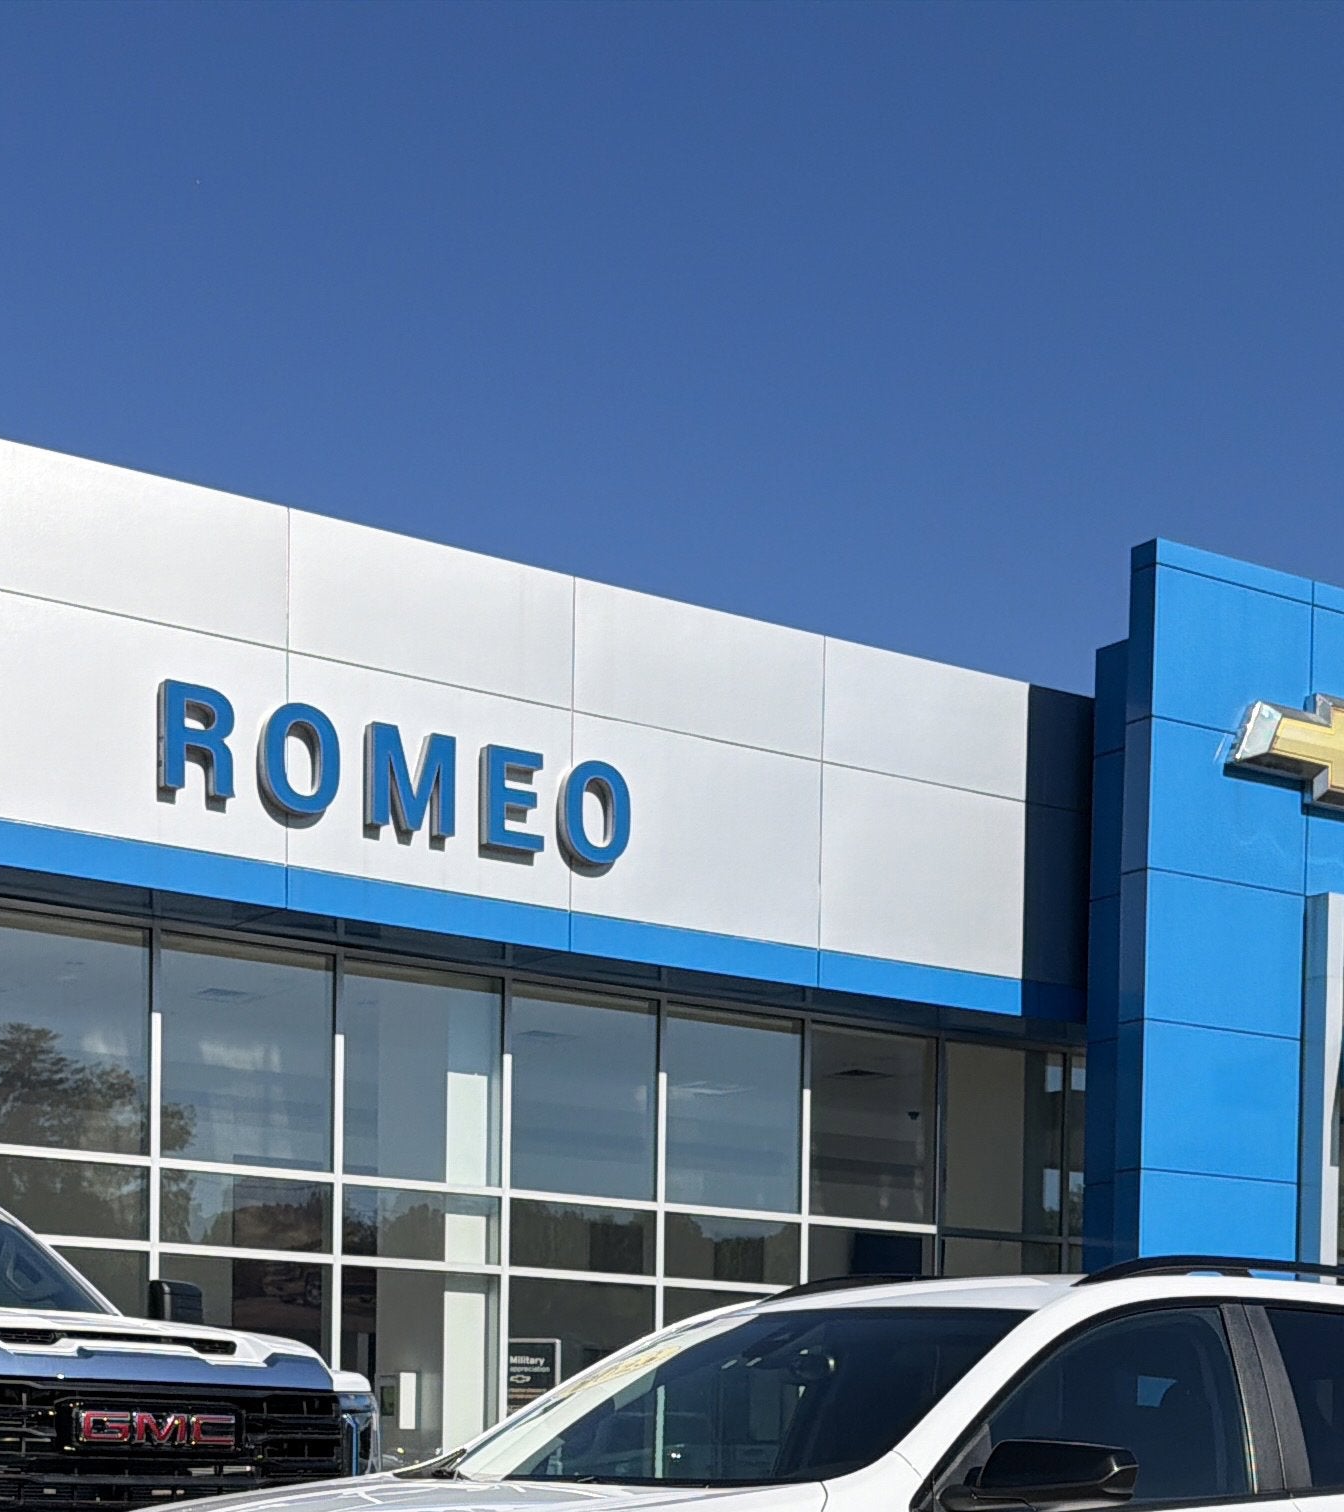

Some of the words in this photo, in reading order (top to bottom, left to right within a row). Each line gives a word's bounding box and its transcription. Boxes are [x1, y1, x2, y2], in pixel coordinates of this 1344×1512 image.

[157, 679, 631, 866] ROMEO
[510, 1355, 545, 1366] Military
[81, 1410, 236, 1445] GMC
